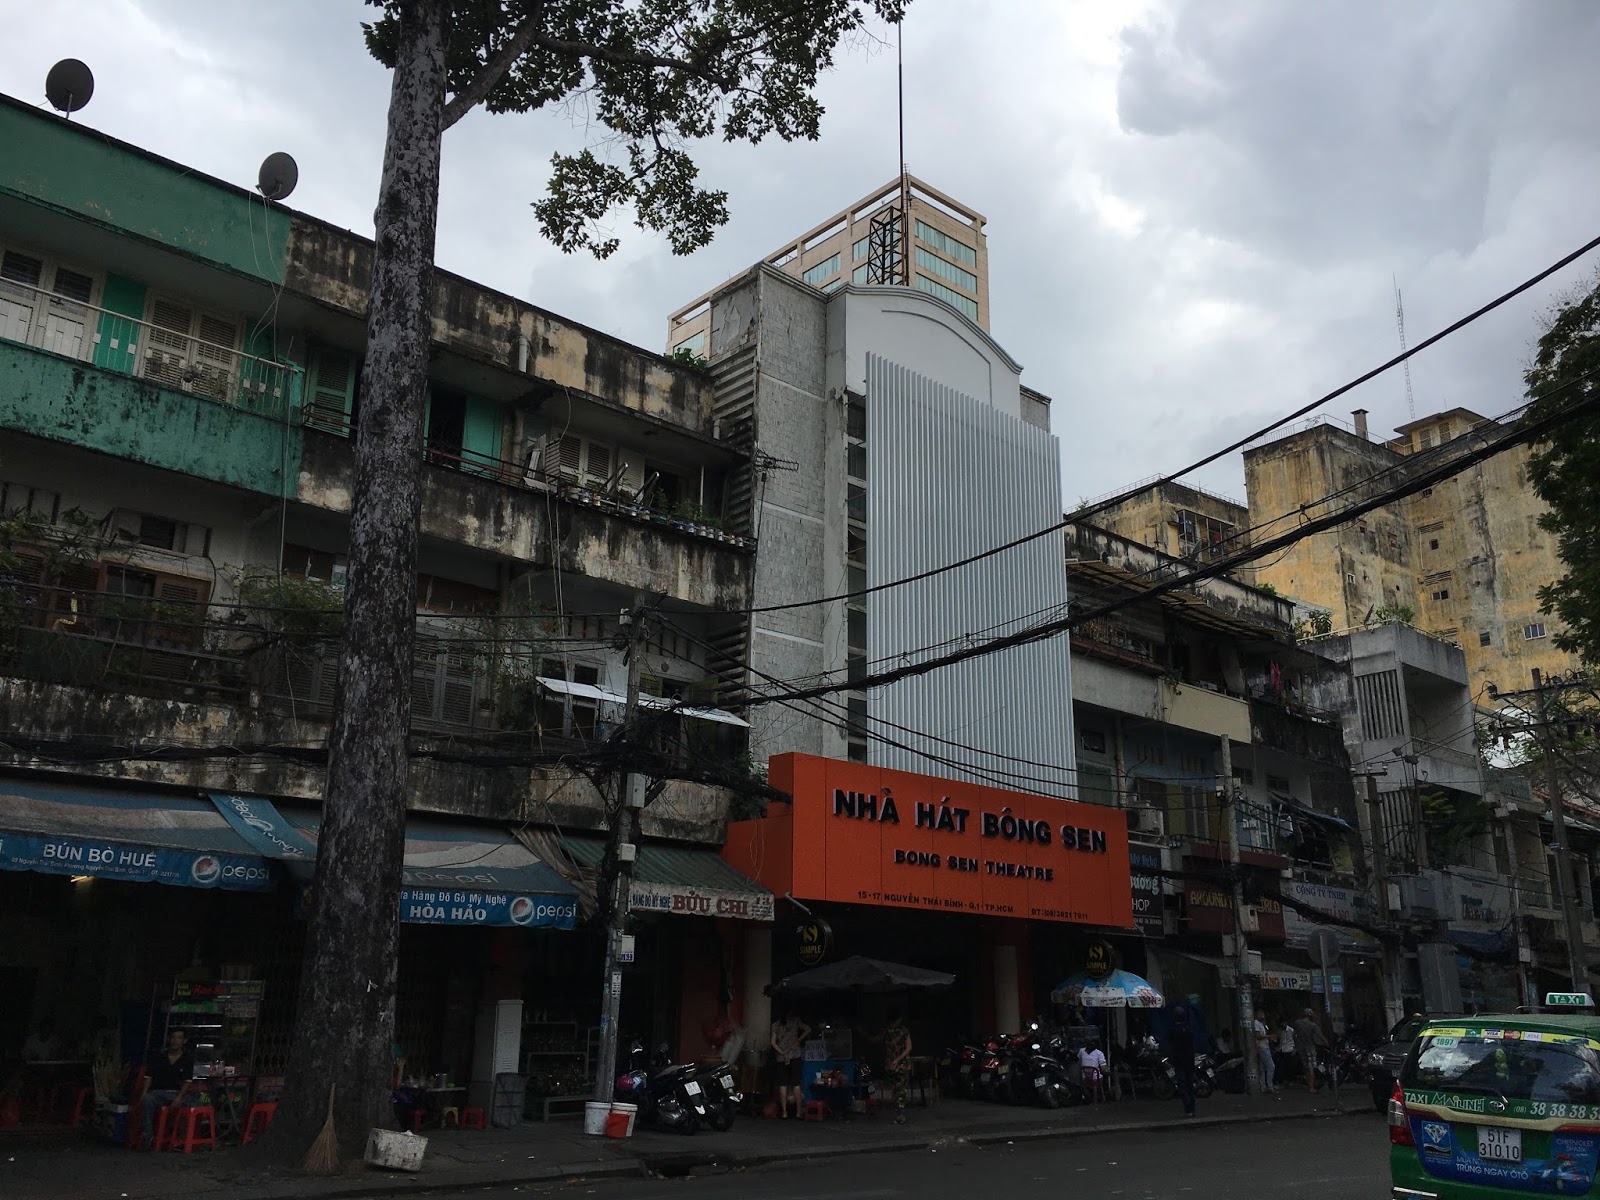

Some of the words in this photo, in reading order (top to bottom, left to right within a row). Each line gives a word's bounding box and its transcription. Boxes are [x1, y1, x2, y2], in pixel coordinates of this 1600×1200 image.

[833, 787, 900, 824] NHÀ
[915, 797, 970, 833] HÁT
[981, 807, 1051, 845] BÔNG
[1060, 825, 1107, 853] SEN
[43, 842, 83, 860] BÚN
[88, 846, 115, 863] BÒ
[221, 864, 270, 881] pepsi
[894, 849, 941, 868] BONG
[946, 855, 979, 872] SEN
[984, 860, 1054, 881] THEATRE
[415, 873, 500, 884] pepsi
[412, 890, 435, 903] Hàng
[469, 893, 482, 905] Mỹ
[485, 894, 507, 906] Nghệ
[1296, 885, 1316, 896] CÔNG
[1317, 890, 1326, 898] TY
[673, 890, 711, 913] BỬU
[716, 898, 748, 915] CHI
[884, 892, 919, 905] NGUYỄN
[923, 896, 942, 907] THÁI
[944, 897, 963, 909] BÌNH
[985, 904, 1014, 913] TP.HCM
[409, 903, 446, 919] HÒA
[451, 904, 487, 920] HẢO
[536, 904, 576, 919] pepsi
[1281, 977, 1297, 988] VIP
[1436, 1038, 1454, 1046] 1897
[1405, 1093, 1428, 1104] TAXI
[1514, 1106, 1527, 1114] (08)
[1530, 1102, 1546, 1116] 38
[1550, 1103, 1566, 1117] 38
[1569, 1104, 1586, 1119] 38
[1487, 1131, 1509, 1144] 51F
[1479, 1143, 1520, 1160] 310.10
[1483, 1168, 1508, 1178] NGAY
